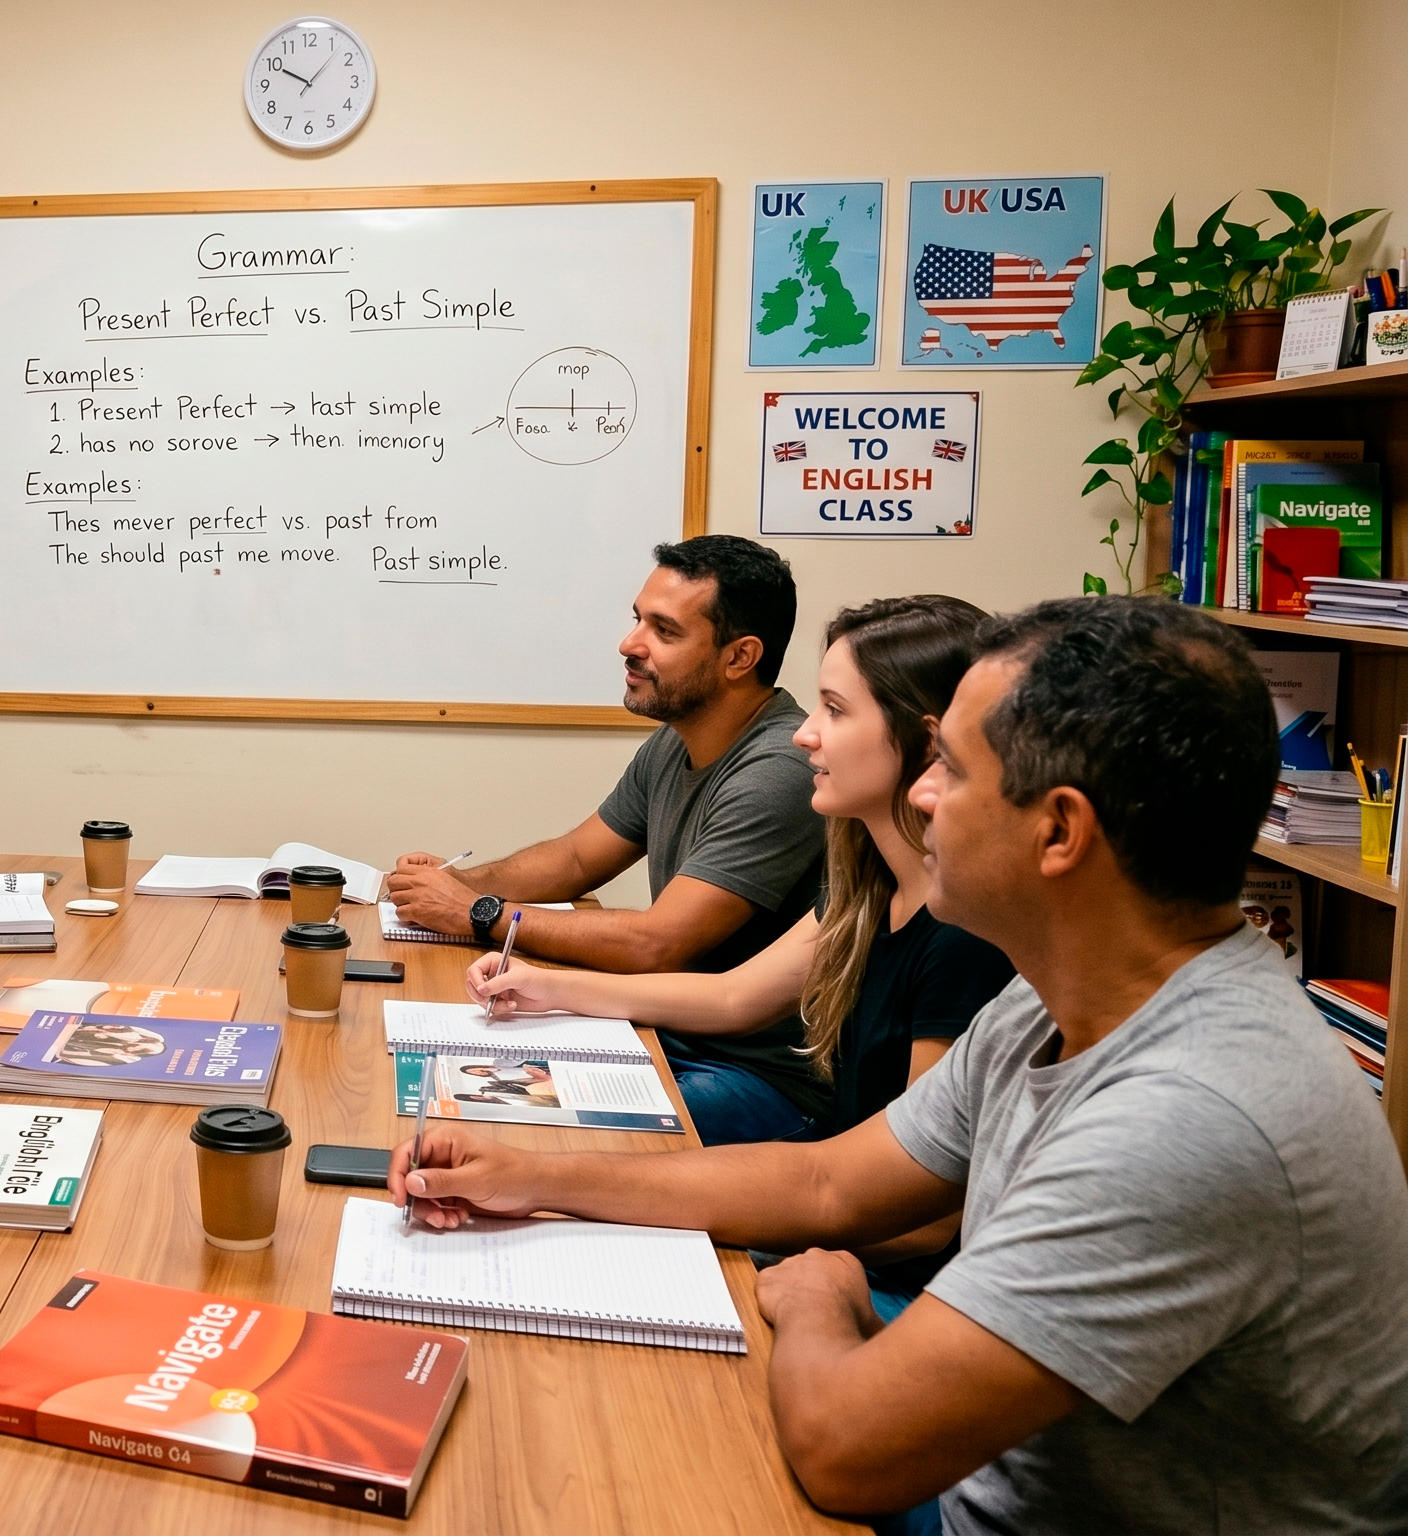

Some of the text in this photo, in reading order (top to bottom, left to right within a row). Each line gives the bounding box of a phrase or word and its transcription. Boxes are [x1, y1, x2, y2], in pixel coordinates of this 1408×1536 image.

[282, 40, 294, 55] 11
[302, 33, 317, 47] 12
[266, 57, 282, 71] 10
[344, 52, 353, 66] 2
[260, 79, 270, 93] 9
[350, 75, 359, 89] 3
[267, 100, 276, 114] 8
[342, 97, 352, 111] 4
[283, 116, 292, 130] 7
[304, 120, 313, 135] 6
[326, 114, 335, 128] 5
[760, 192, 806, 217] UK
[77, 288, 516, 331] Present Perfect vs. Past Simple
[49, 401, 66, 423] 1.
[77, 396, 163, 422] Present
[177, 393, 258, 420] Perfect
[369, 390, 442, 424] simple
[794, 407, 946, 430] WELCOME
[49, 434, 69, 455] 2.
[80, 432, 117, 453] has
[129, 436, 155, 453] no
[167, 434, 239, 452] sorove
[848, 438, 889, 461] TO
[802, 468, 933, 491] ENGLISH
[819, 499, 914, 521] CLASS
[1280, 501, 1371, 521] Navigate
[47, 505, 437, 540] Thes mever perfect vs. past from
[49, 542, 90, 565] The
[101, 542, 165, 564] should
[180, 541, 225, 573] past
[238, 549, 271, 564] me
[372, 545, 420, 572] Past
[123, 1303, 238, 1412] Navigate
[89, 1430, 164, 1460] Navigate
